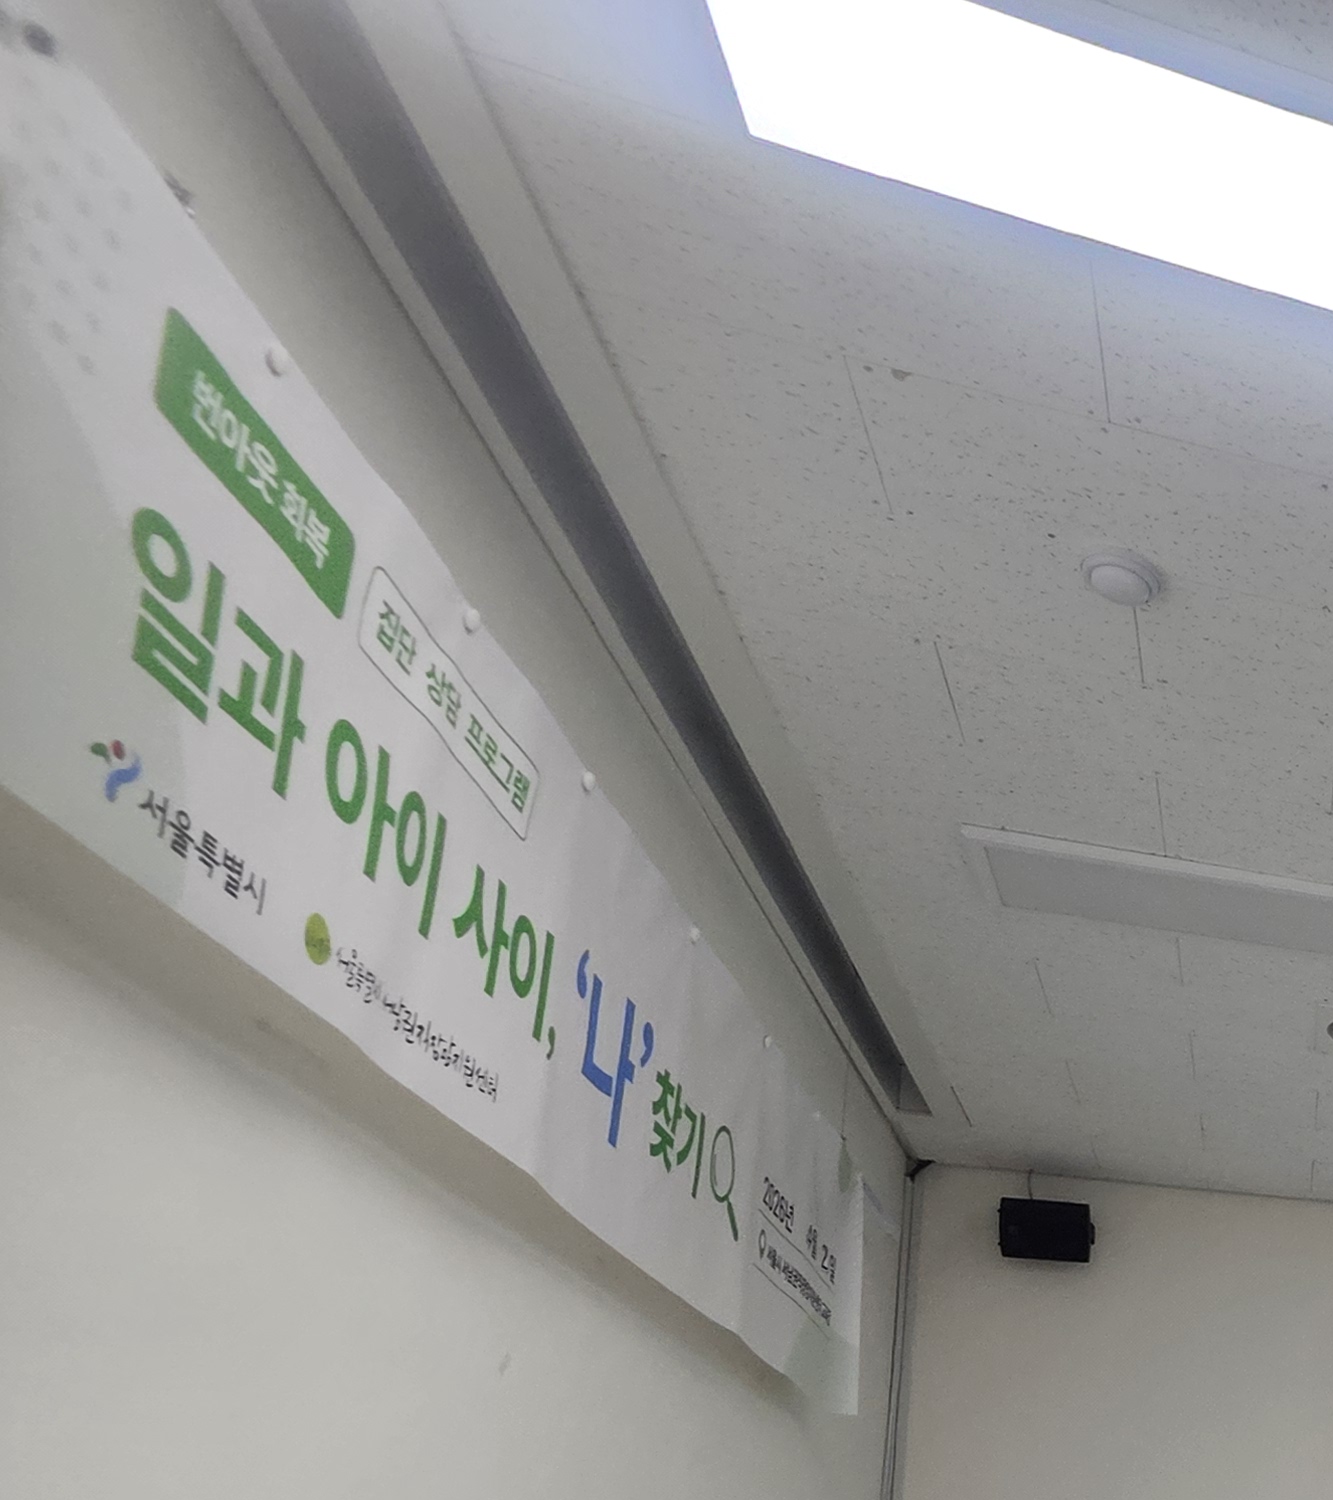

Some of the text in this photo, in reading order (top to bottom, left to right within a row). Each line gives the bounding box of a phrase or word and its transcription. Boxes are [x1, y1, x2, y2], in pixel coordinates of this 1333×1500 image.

[192, 370, 331, 569] 번아웃 회복
[376, 599, 531, 814] 집단 상담 프로그램
[131, 507, 306, 801] 일과
[325, 718, 447, 940] 아이
[452, 863, 555, 1061] 사이,
[649, 1068, 706, 1199] 찾기
[138, 789, 267, 916] 서울특별시
